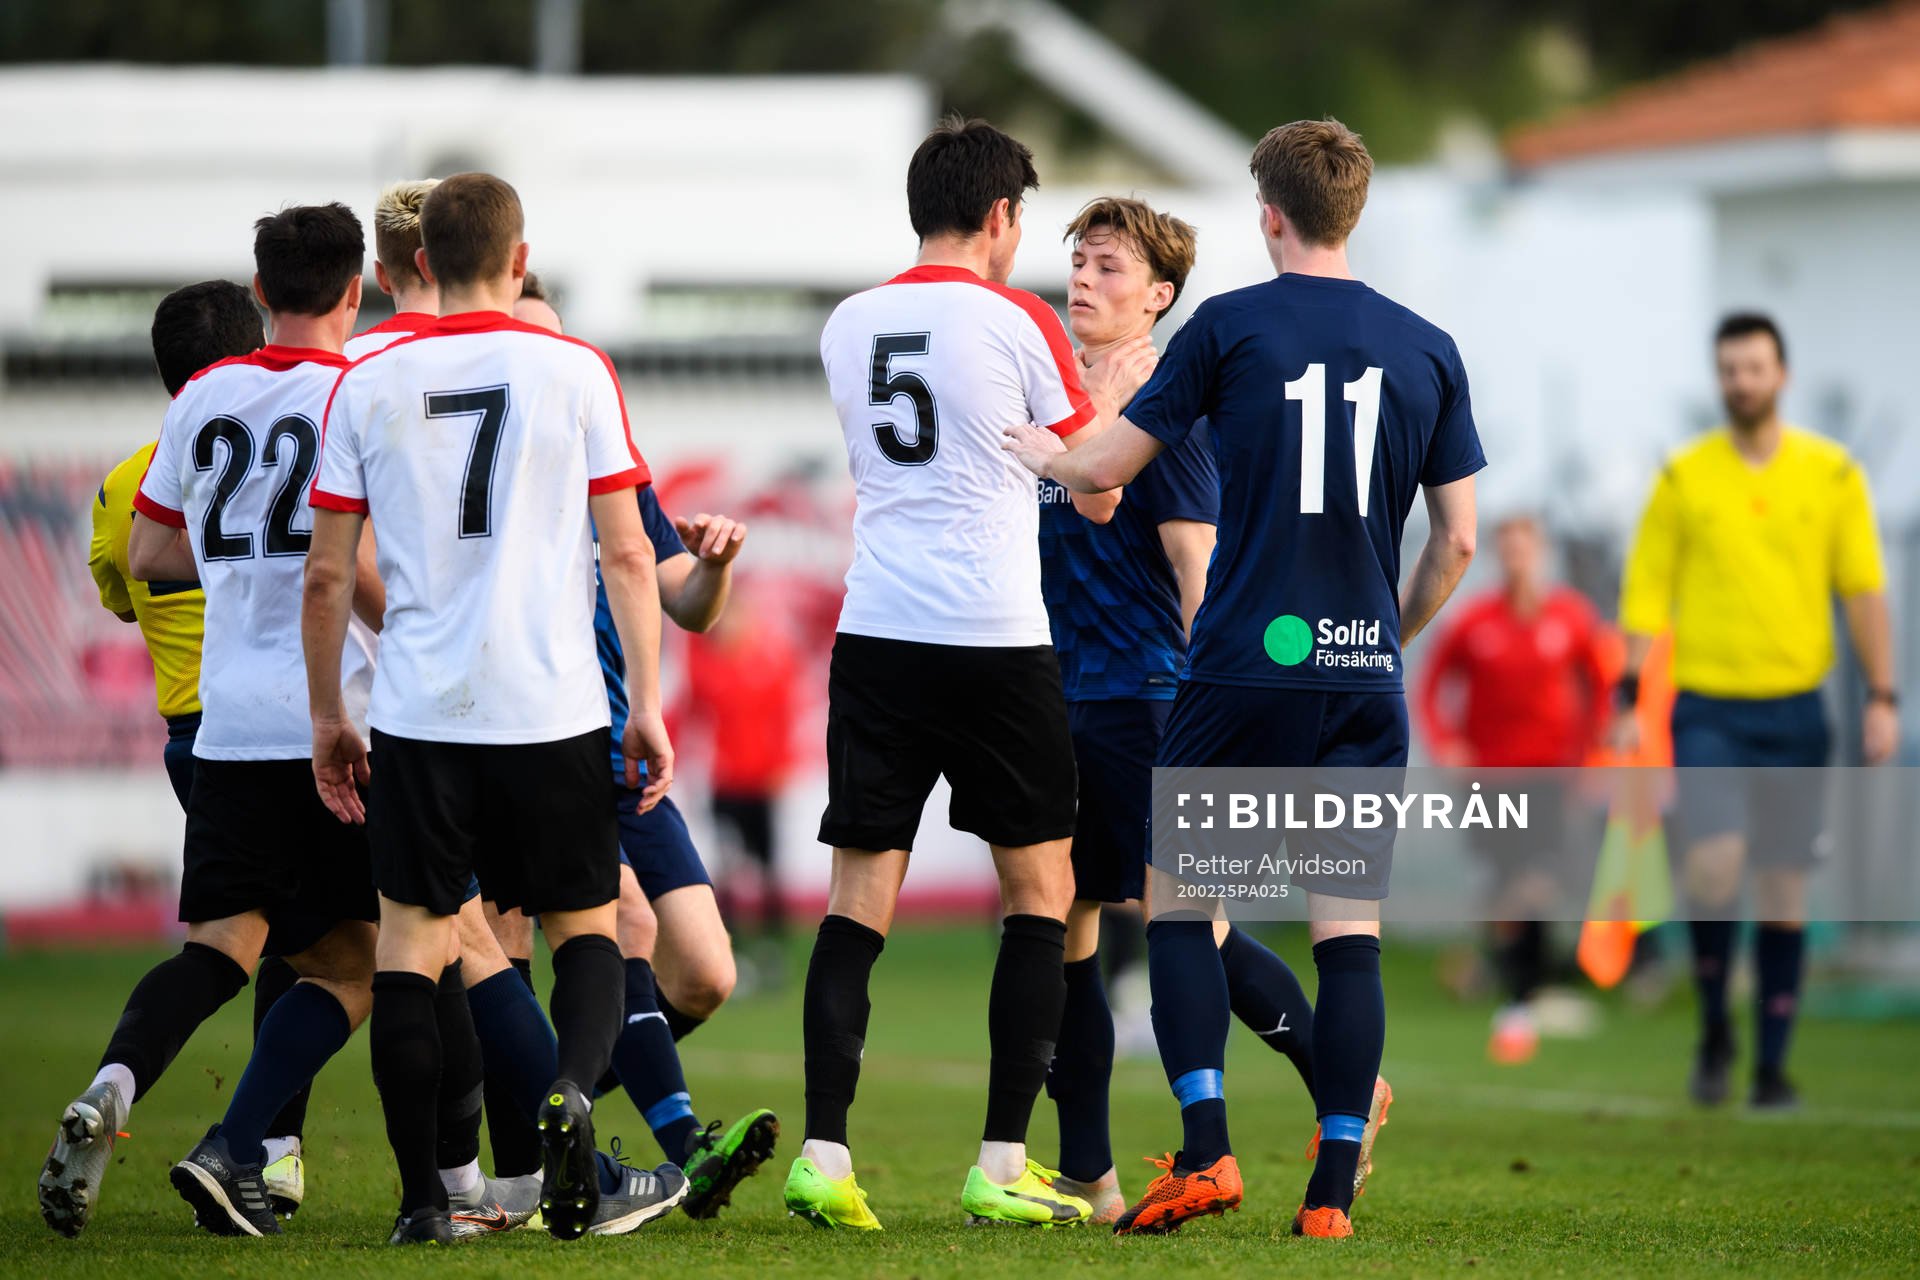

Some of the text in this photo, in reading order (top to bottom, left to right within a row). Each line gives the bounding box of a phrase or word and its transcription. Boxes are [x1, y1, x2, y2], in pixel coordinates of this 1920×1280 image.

[868, 331, 939, 466] 5
[424, 383, 511, 539] 7
[1284, 363, 1384, 518] 11
[192, 412, 320, 562] 22
[1038, 480, 1071, 504] Ban
[1315, 649, 1394, 672] Försäkring
[1316, 618, 1380, 646] Solid
[196, 1153, 231, 1180] gala
